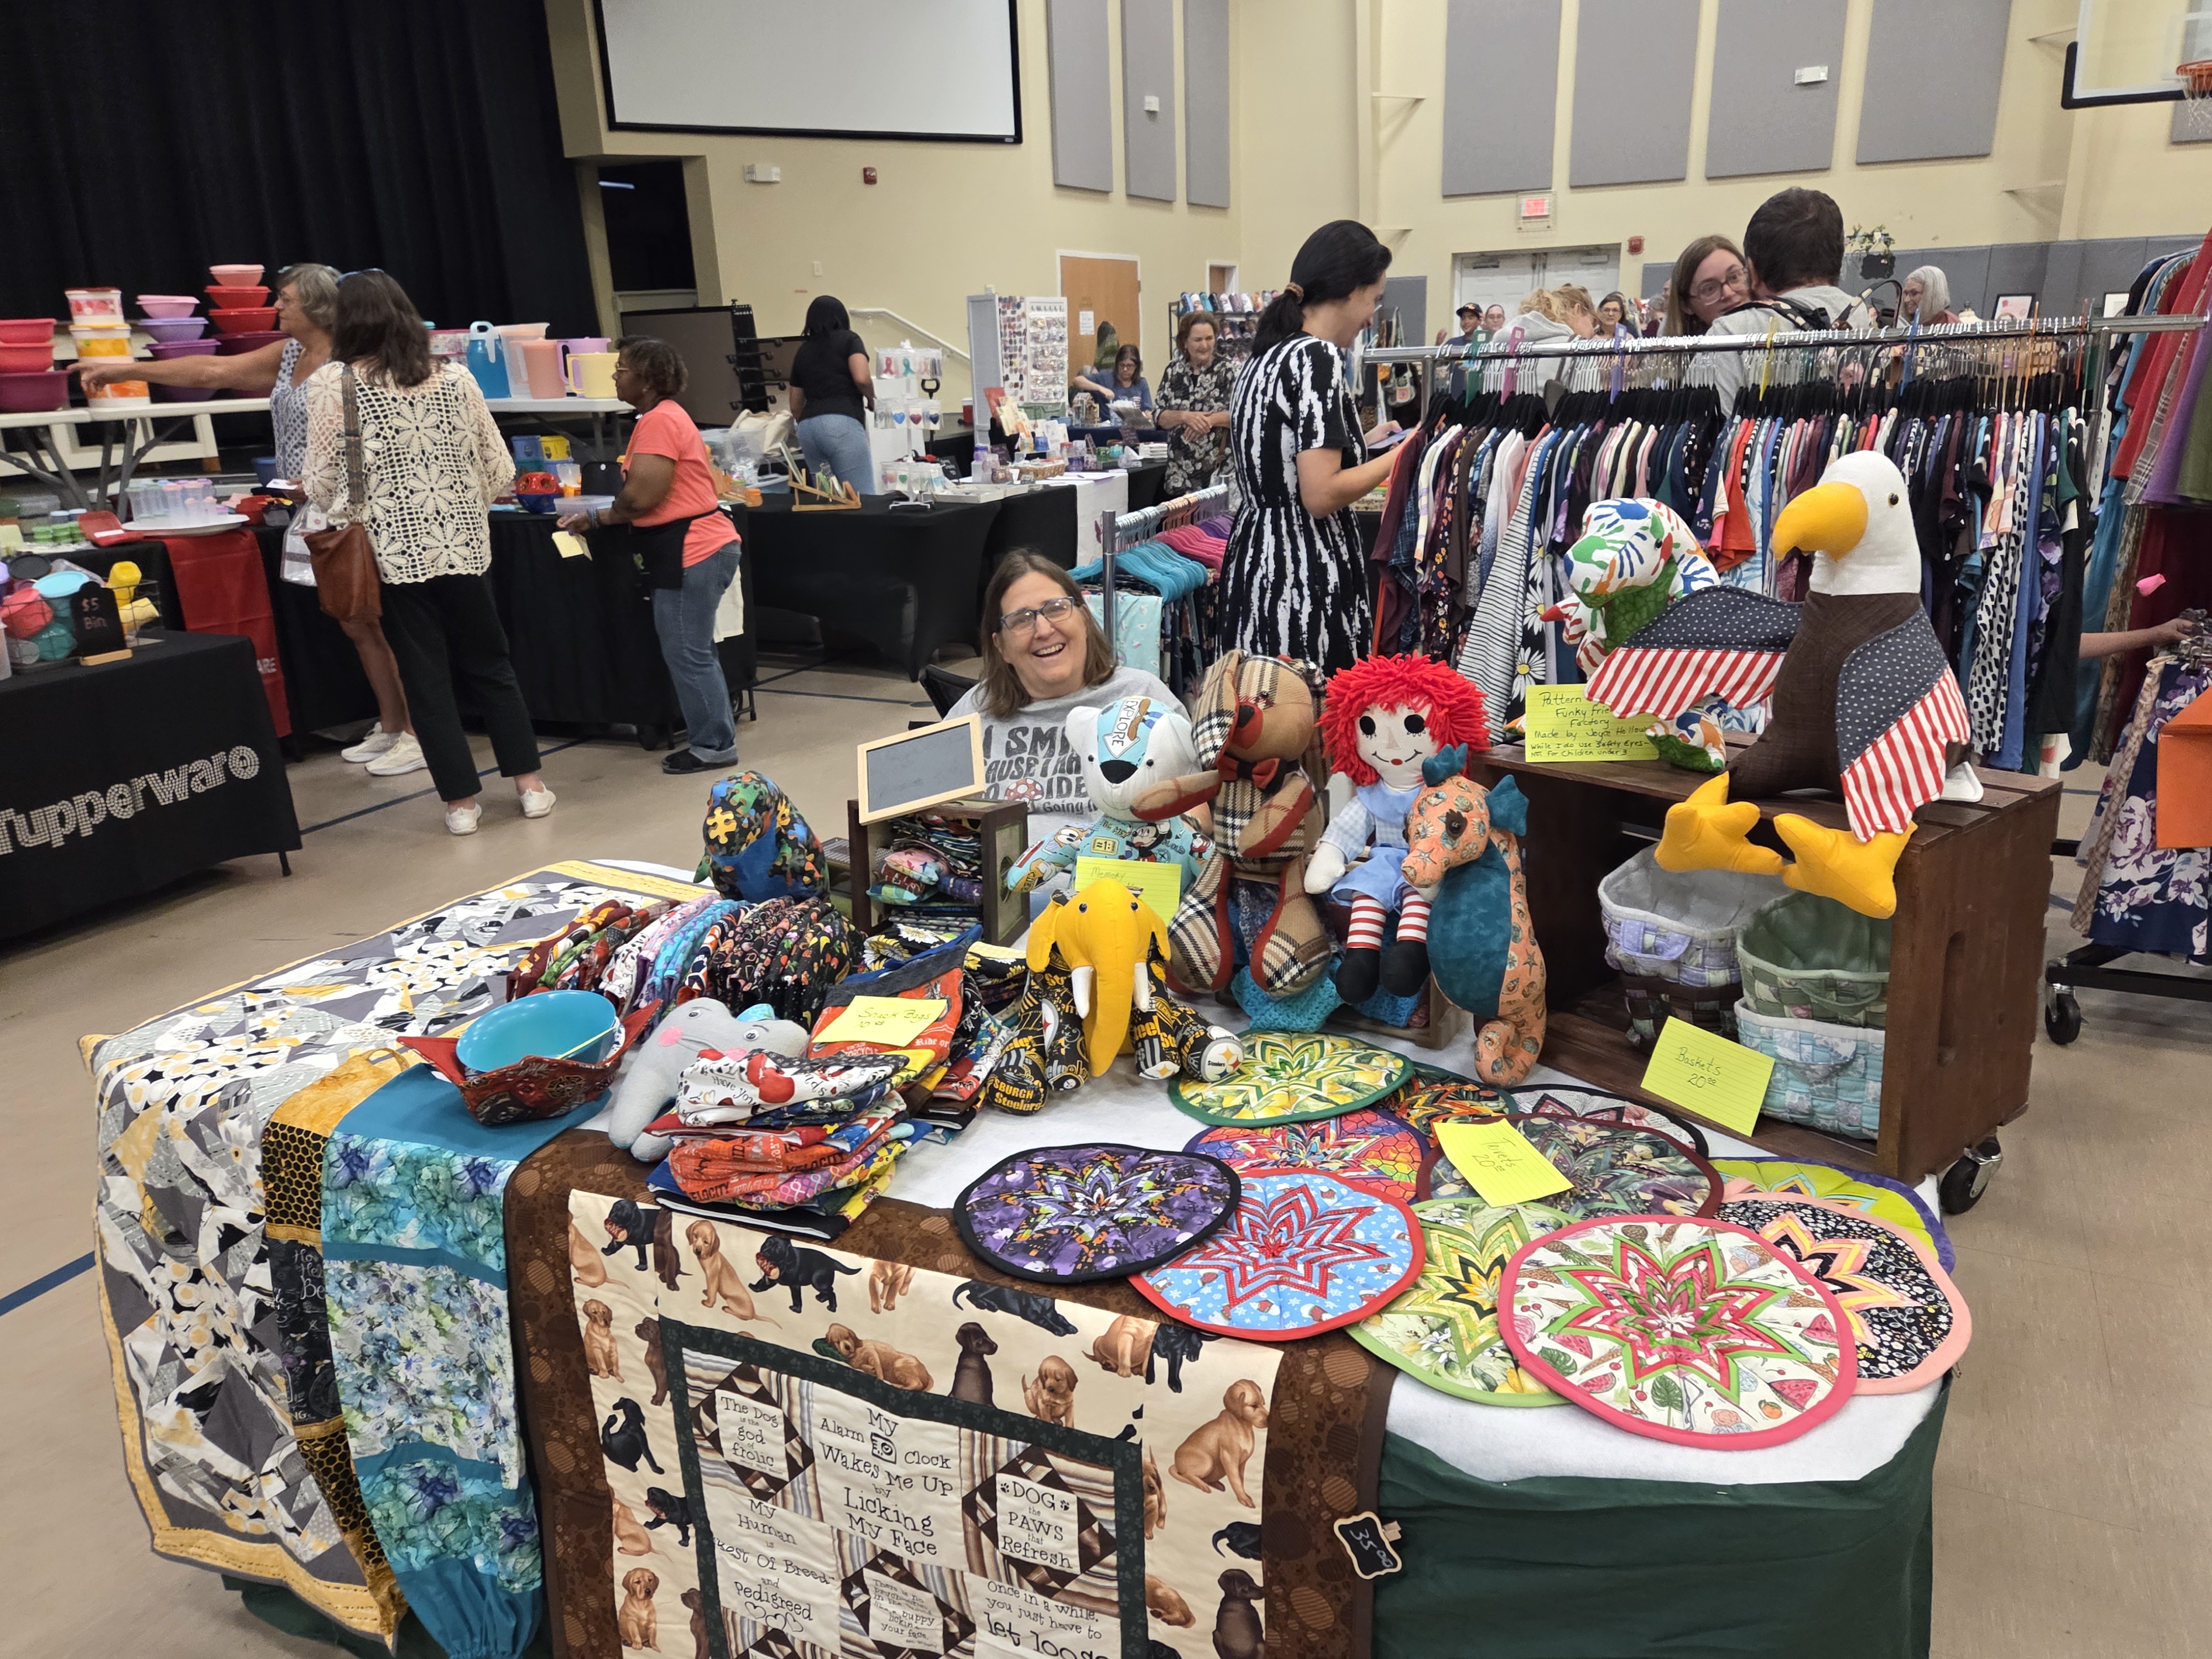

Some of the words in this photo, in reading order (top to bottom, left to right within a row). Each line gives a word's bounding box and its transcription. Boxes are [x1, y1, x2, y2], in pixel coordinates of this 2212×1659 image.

[1539, 691, 1582, 707] Pattern
[1112, 700, 1139, 747] EXPLORE
[1556, 708, 1587, 720] Funky
[1570, 718, 1610, 730] Factory
[983, 724, 994, 759] I
[1535, 728, 1559, 739] Made
[1566, 729, 1577, 742] by
[1043, 801, 1084, 815] Going
[858, 1007, 900, 1020] Snack
[903, 1009, 932, 1024] Bags
[914, 1038, 937, 1047] Ride
[1674, 1046, 1722, 1077] Baskets
[994, 1092, 1043, 1112] Steelers
[721, 1396, 748, 1414] The
[753, 1406, 779, 1428] Dog
[866, 1407, 899, 1437] My
[737, 1426, 766, 1444] god
[820, 1418, 865, 1443] Alarm
[904, 1451, 952, 1469] Clock
[732, 1442, 774, 1467] frolic
[818, 1441, 880, 1479] Wakes
[885, 1470, 914, 1491] Me
[921, 1475, 953, 1496] Up
[872, 1483, 892, 1499] by
[1011, 1481, 1056, 1511] DOG
[747, 1499, 777, 1519] My
[843, 1486, 934, 1537] Licking
[1029, 1506, 1041, 1517] the
[737, 1513, 798, 1546] Human
[846, 1512, 883, 1540] My
[889, 1528, 937, 1556] Face
[1008, 1511, 1064, 1542] PAWS
[1028, 1532, 1045, 1546] that
[757, 1553, 778, 1571] Of
[1001, 1535, 1074, 1569] Refresh
[761, 1577, 780, 1590] and
[872, 1578, 898, 1592] There
[734, 1581, 813, 1621] Pedigreed
[987, 1580, 1020, 1599] Once
[1024, 1593, 1040, 1606] in
[1044, 1599, 1051, 1613] a
[880, 1622, 905, 1635] your
[902, 1610, 936, 1627] puppy
[983, 1611, 1021, 1647] let
[985, 1597, 1013, 1613] you
[1017, 1605, 1045, 1626] just
[1049, 1616, 1083, 1634] have
[1088, 1625, 1103, 1640] to
